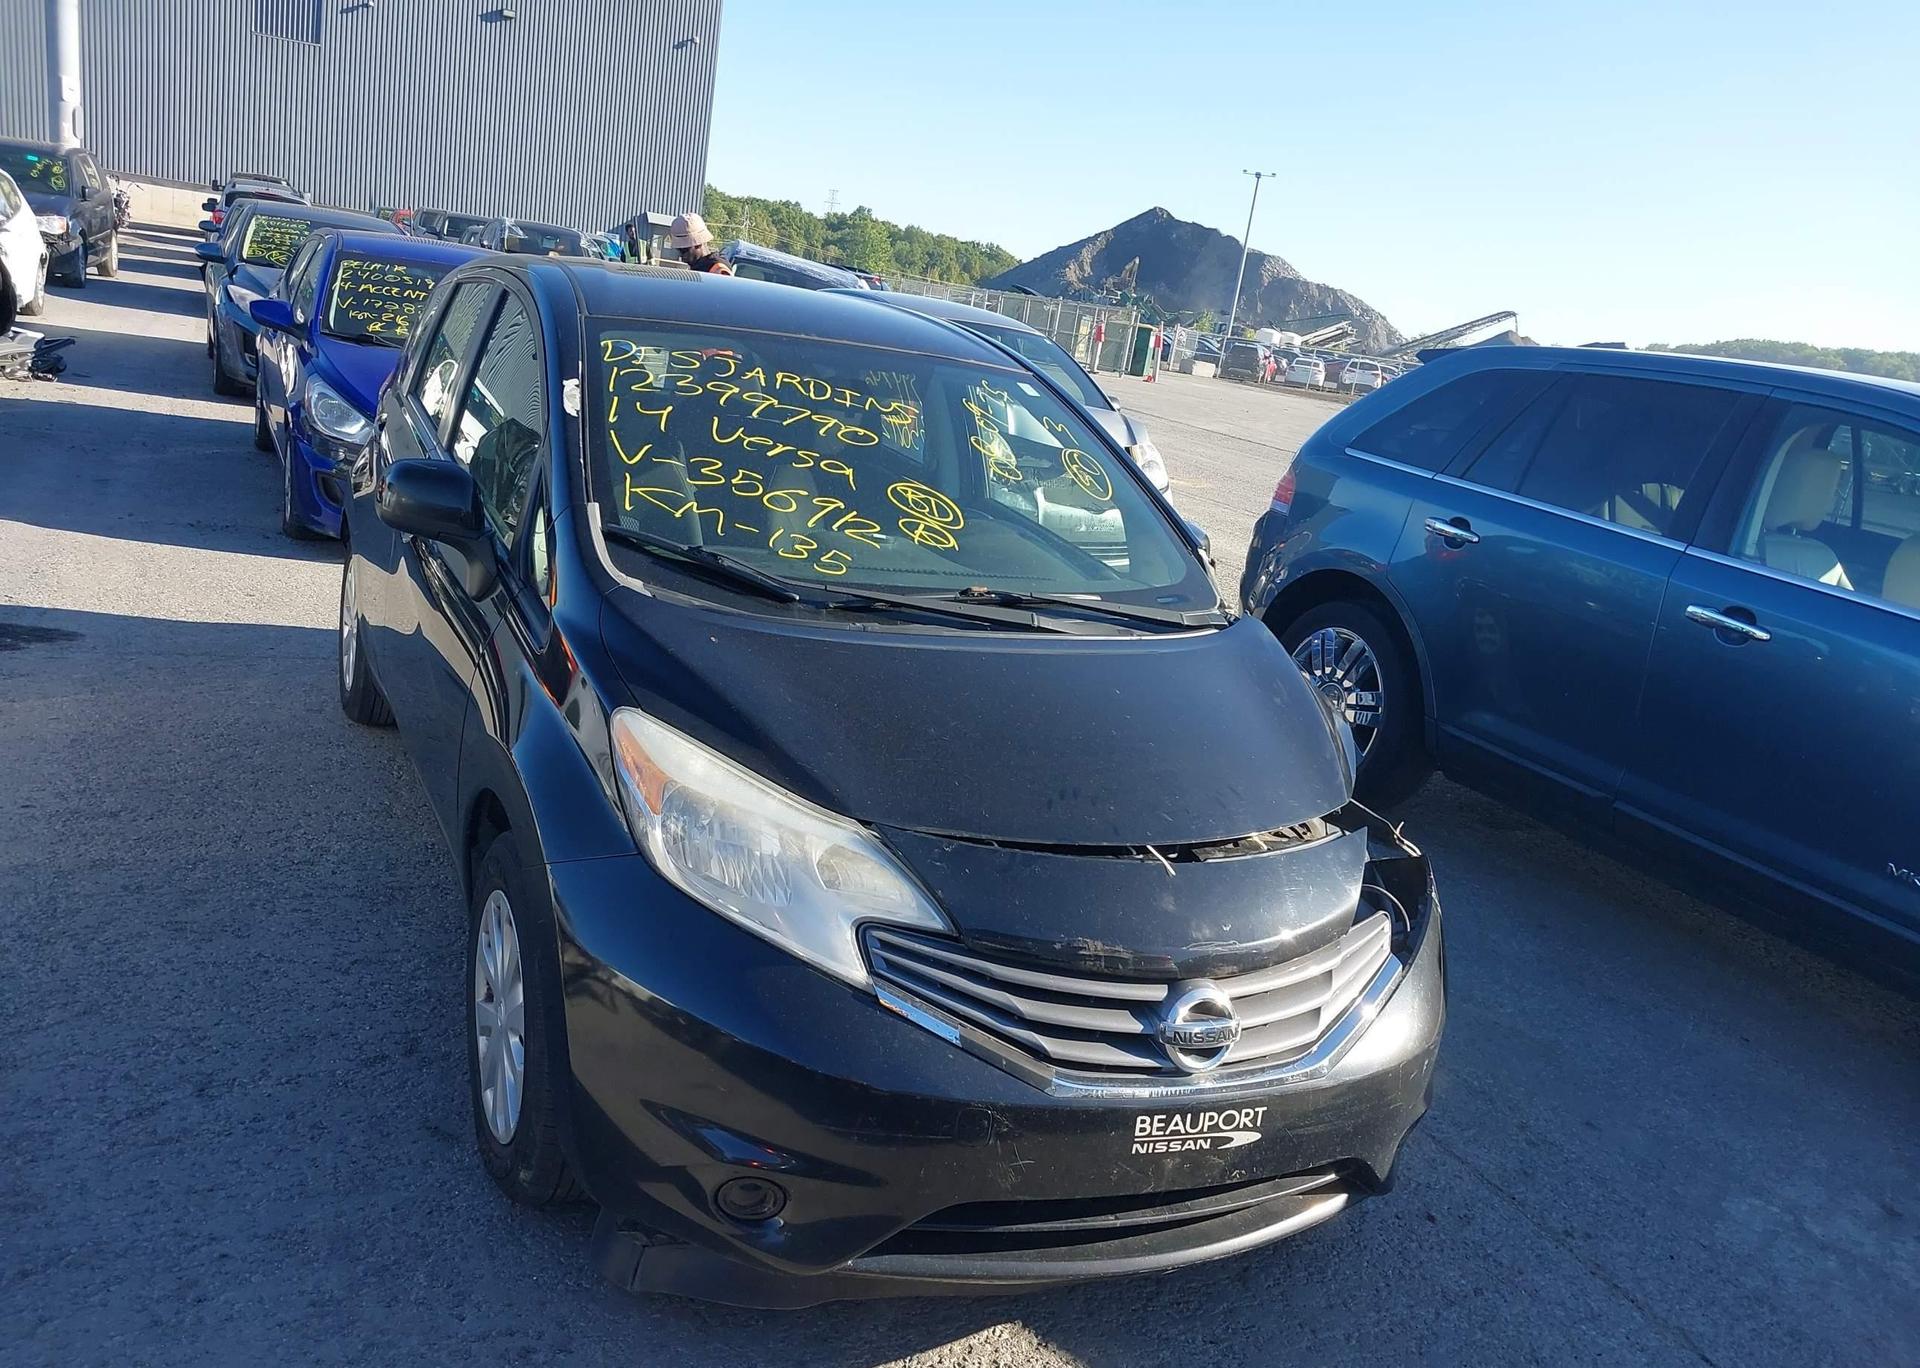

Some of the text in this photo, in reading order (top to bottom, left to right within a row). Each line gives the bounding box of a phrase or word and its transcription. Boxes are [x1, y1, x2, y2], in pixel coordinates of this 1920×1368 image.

[608, 366, 879, 446] 12399790
[608, 396, 673, 432] 14
[1172, 1028, 1239, 1045] NISSAN
[1134, 1106, 1268, 1137] BEAUPORT
[1131, 1138, 1211, 1155] NISSAN
